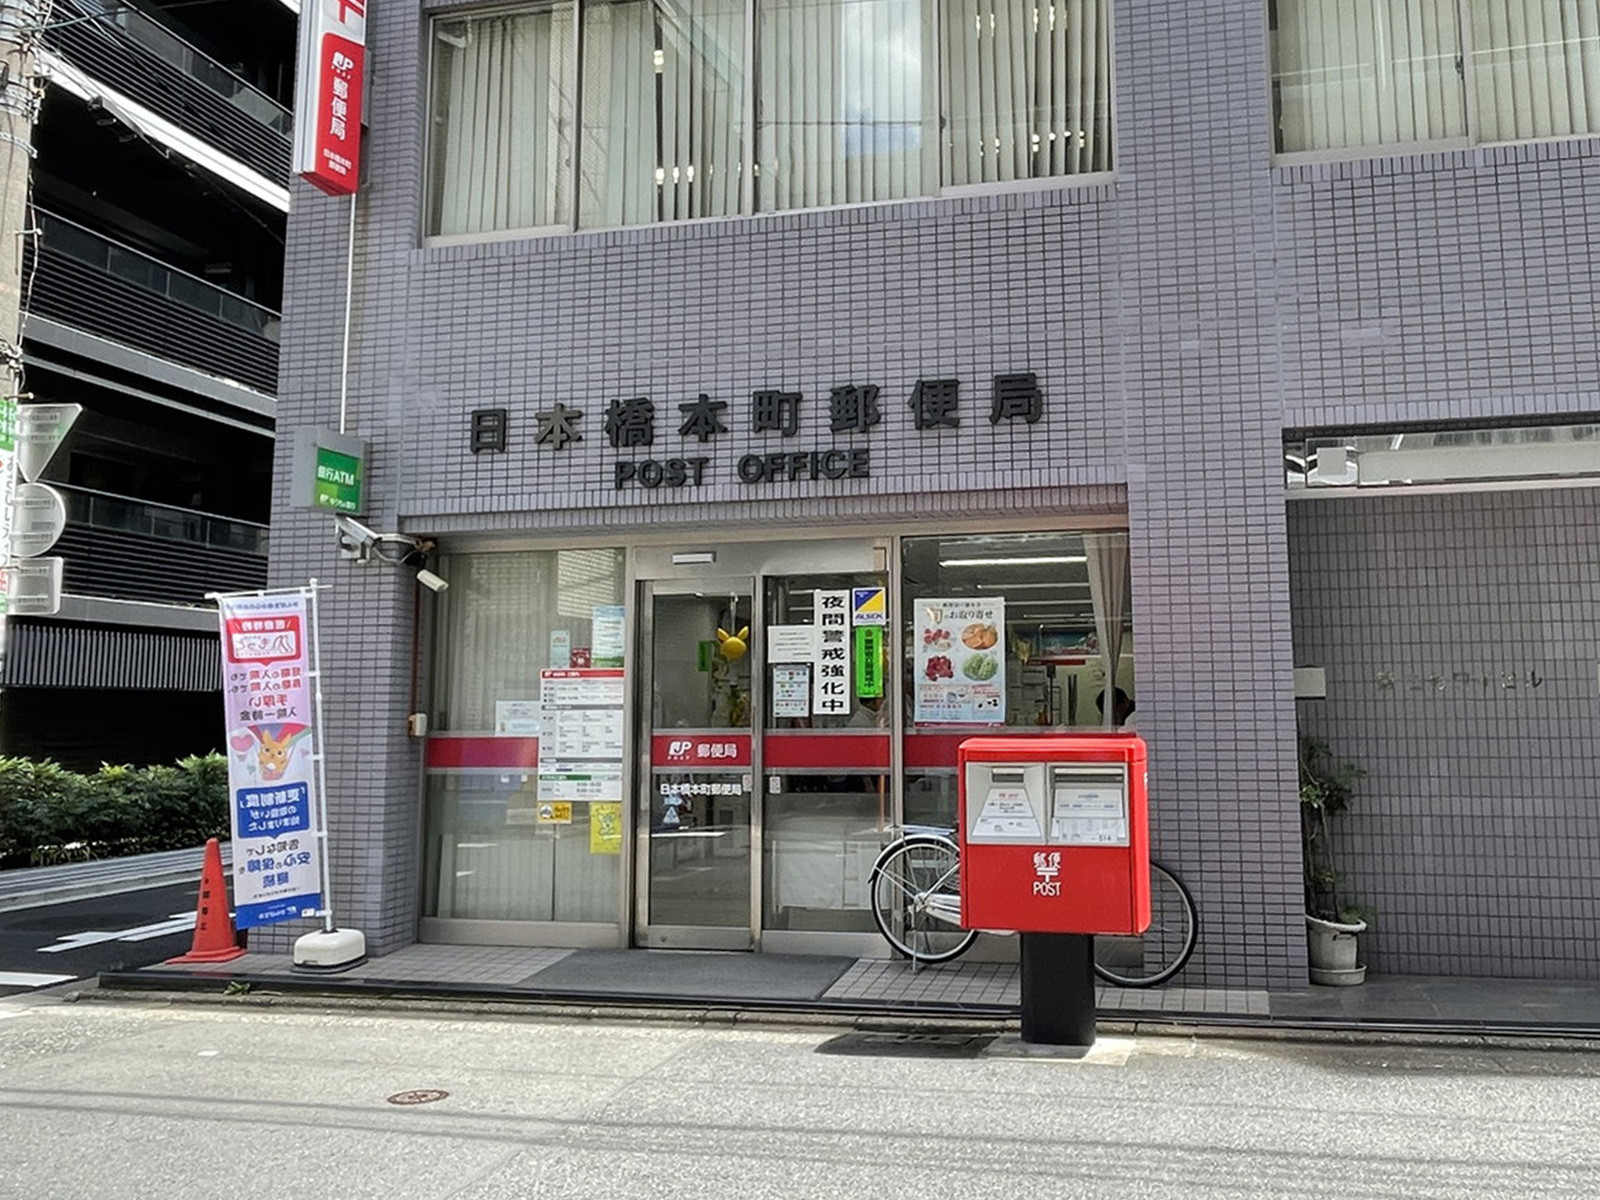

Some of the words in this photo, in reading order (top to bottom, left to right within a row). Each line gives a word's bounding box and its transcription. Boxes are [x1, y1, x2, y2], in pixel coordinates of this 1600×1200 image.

[330, 76, 349, 141] 郵便局
[470, 372, 1043, 453] 日本橋本町郵便局
[615, 457, 709, 490] POST
[738, 450, 870, 484] OFFICE
[821, 595, 845, 712] 夜間警戒強化中
[697, 743, 737, 758] 郵便局
[660, 783, 742, 796] 日本橋本町郵便局
[1033, 852, 1061, 869] 郵便
[1033, 881, 1062, 896] POST
